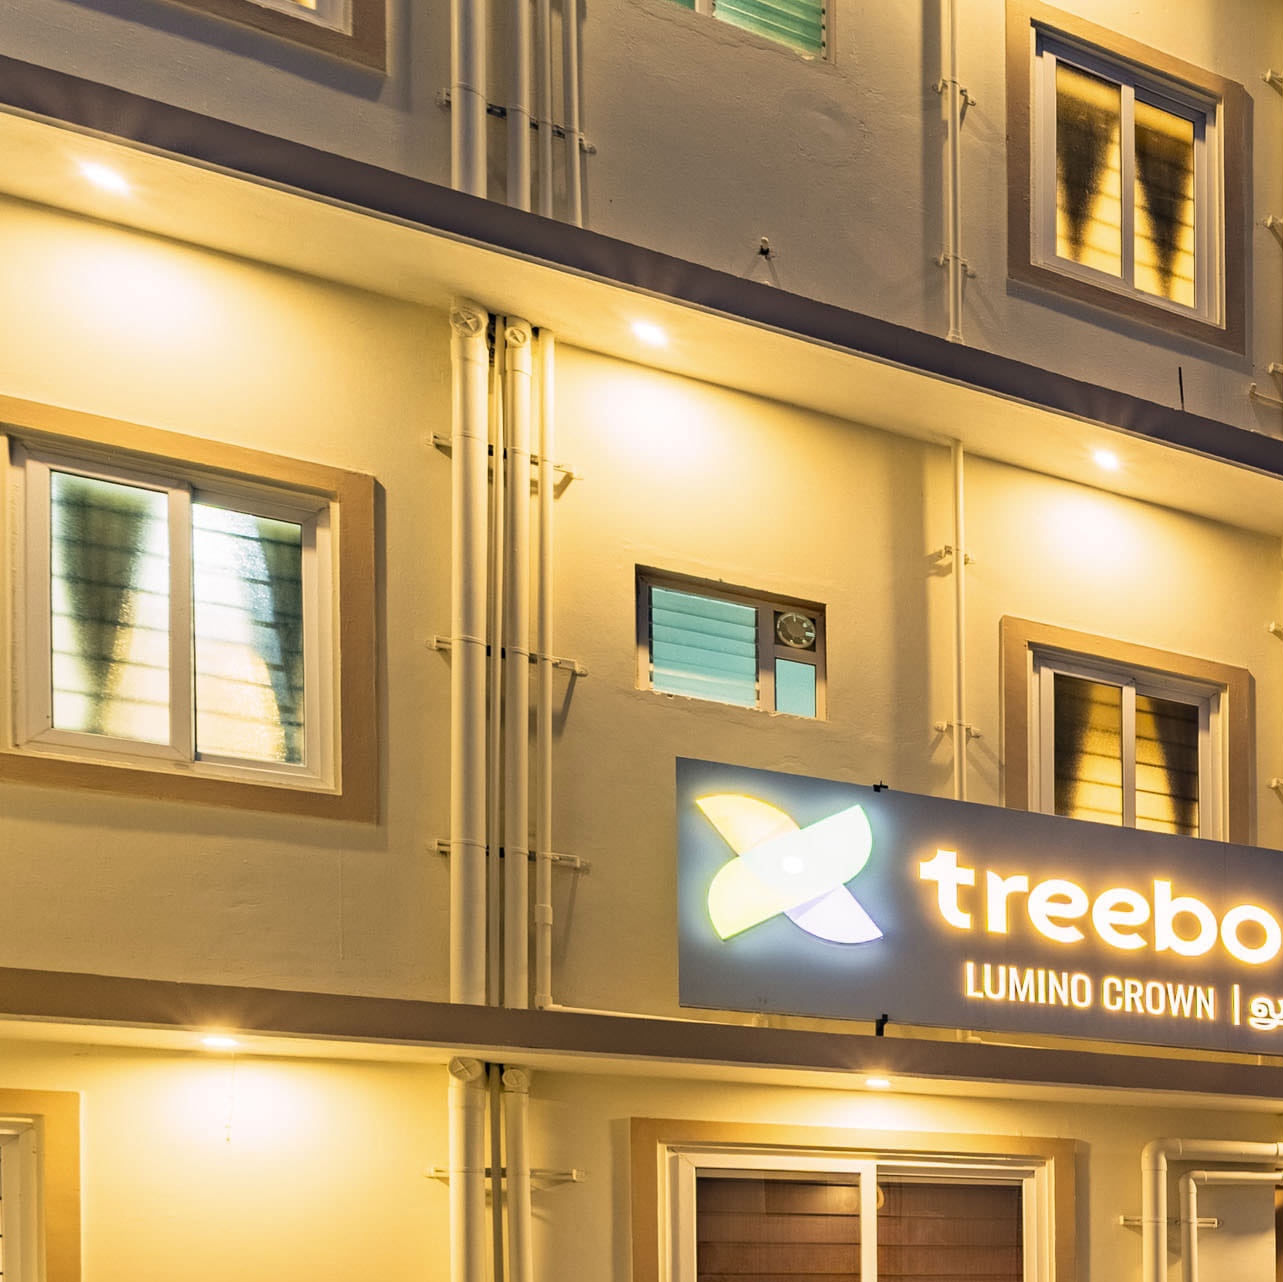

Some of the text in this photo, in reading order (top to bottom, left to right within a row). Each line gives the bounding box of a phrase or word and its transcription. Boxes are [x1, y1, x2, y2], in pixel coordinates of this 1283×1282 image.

[919, 848, 1283, 965] treebo
[965, 961, 1216, 1021] LUMINO CROWN
